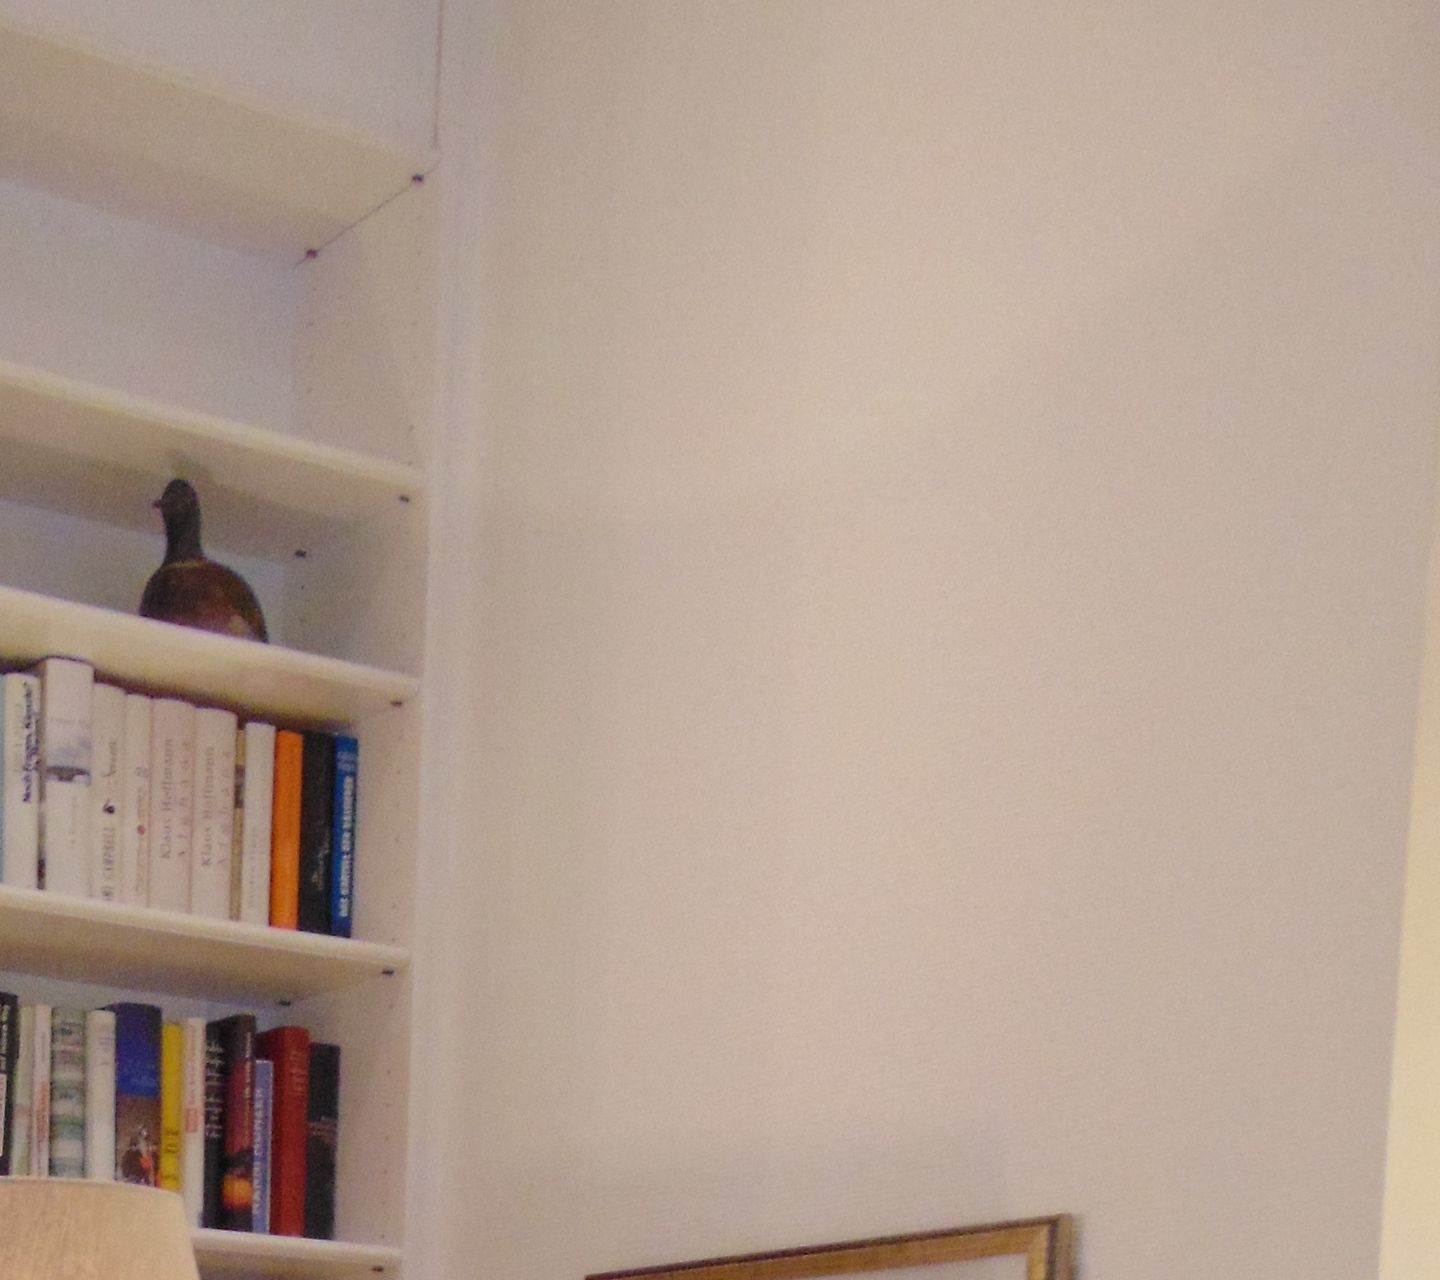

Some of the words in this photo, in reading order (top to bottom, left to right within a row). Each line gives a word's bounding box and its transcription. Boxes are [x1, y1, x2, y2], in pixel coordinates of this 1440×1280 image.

[160, 738, 174, 813] Hoffmann
[160, 819, 172, 860] Klaus
[200, 827, 213, 867] Klaus
